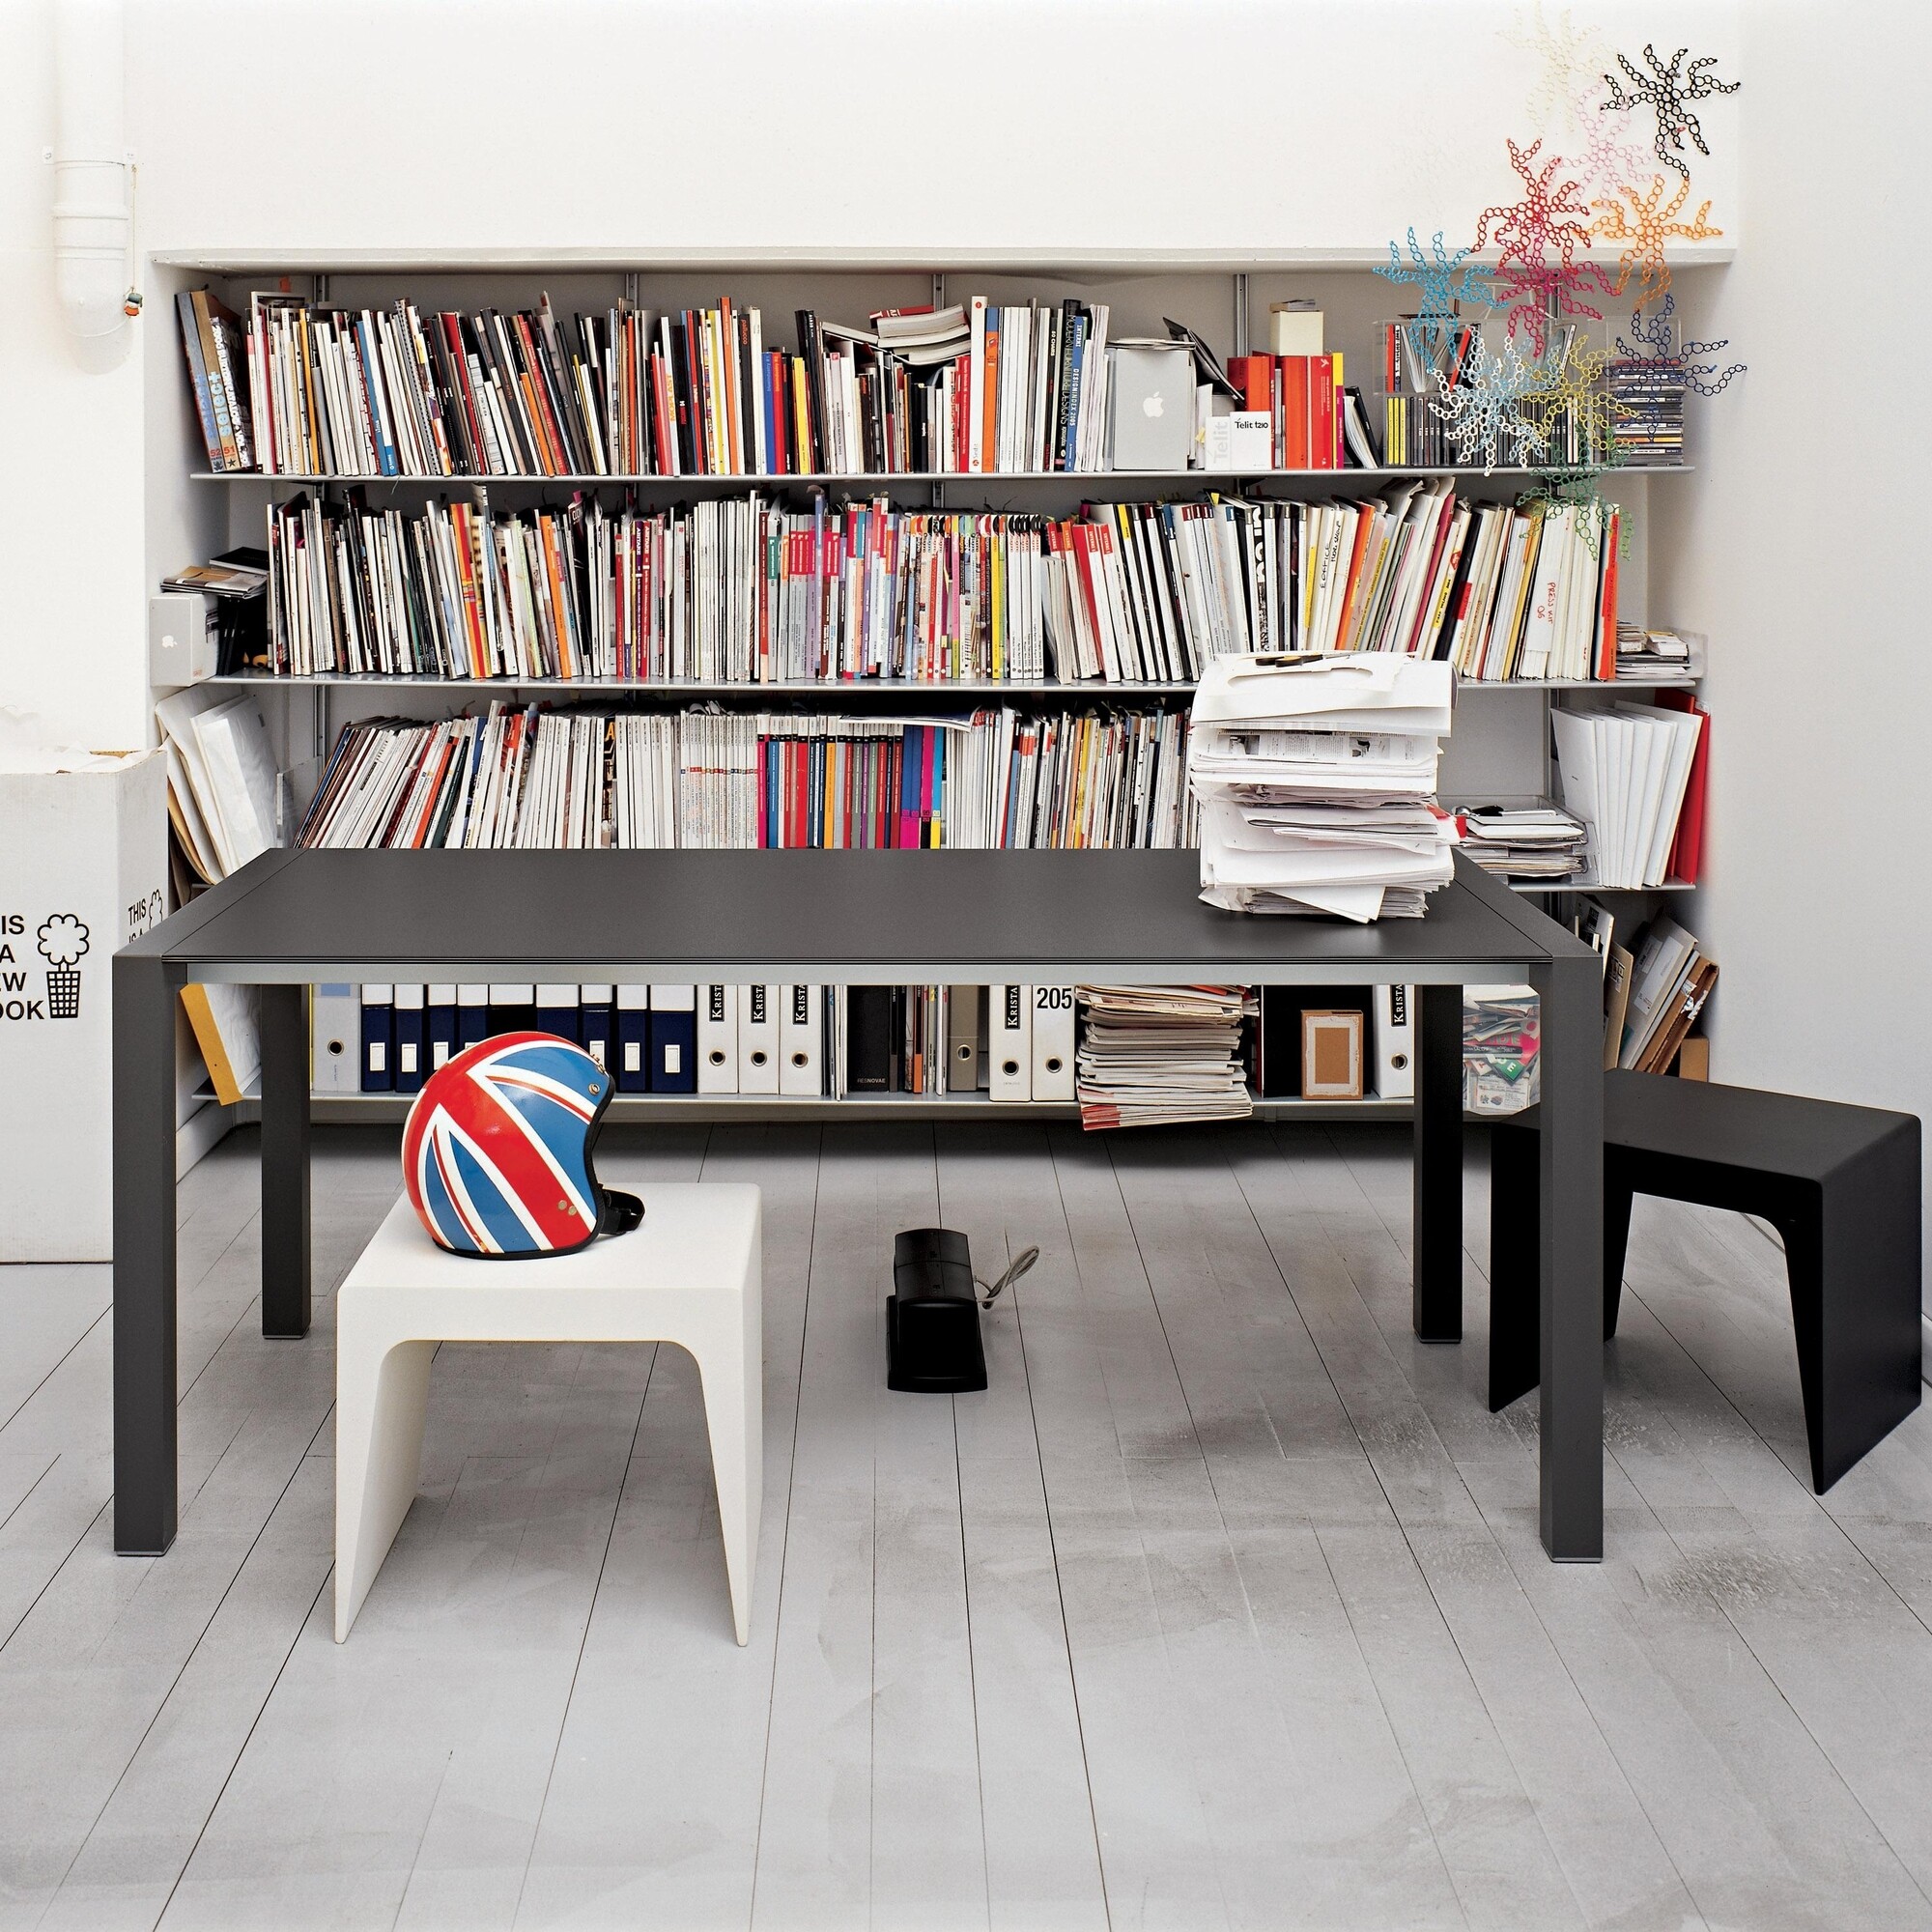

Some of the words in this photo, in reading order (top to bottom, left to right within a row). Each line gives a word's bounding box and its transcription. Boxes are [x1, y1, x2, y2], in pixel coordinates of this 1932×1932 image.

[1235, 417, 1253, 429] Telit
[1548, 582, 1556, 609] PRESS
[128, 898, 146, 925] THIS
[0, 972, 26, 992] W
[1037, 987, 1071, 1009] 205
[0, 1000, 44, 1021] OK
